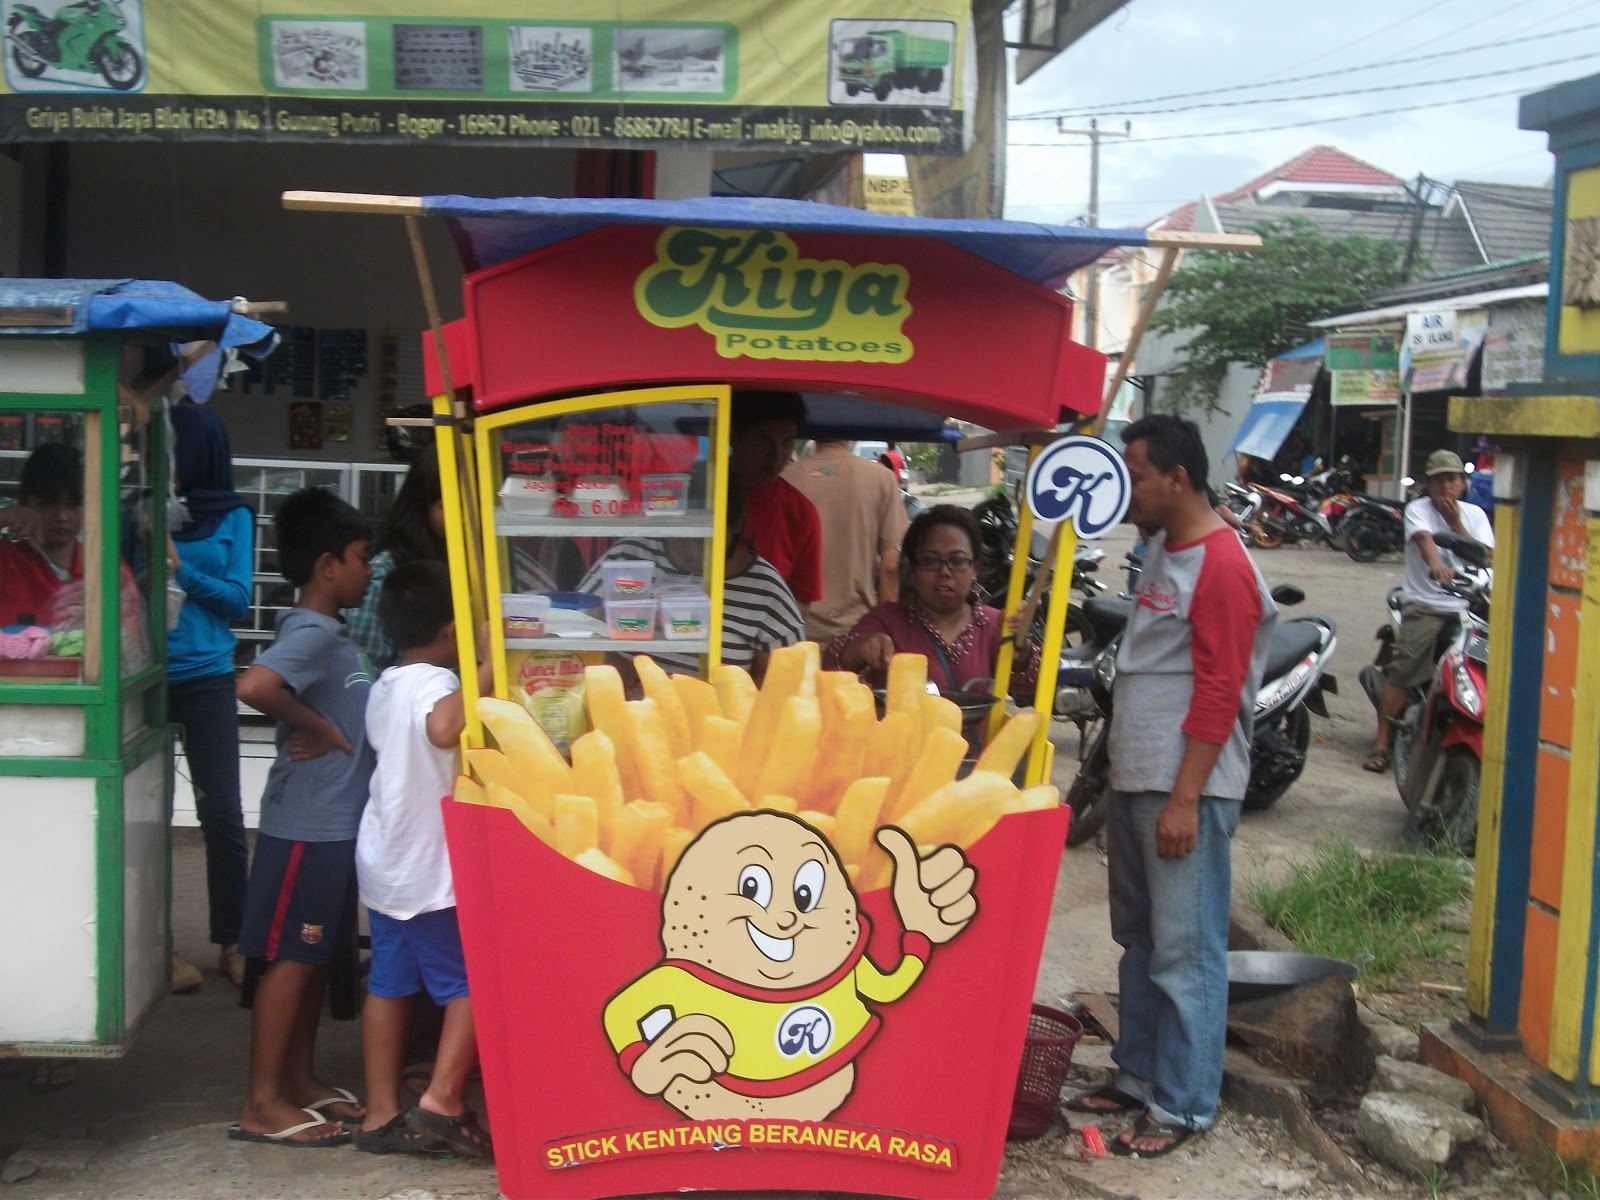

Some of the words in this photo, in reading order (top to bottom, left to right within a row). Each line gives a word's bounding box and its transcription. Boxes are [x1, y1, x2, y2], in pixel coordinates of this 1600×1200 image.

[25, 106, 70, 132] Griya
[72, 106, 115, 129] Bukit
[117, 107, 152, 134] Jaya
[154, 107, 192, 129] Blok
[276, 109, 339, 137] Gunung
[341, 111, 381, 133] Putri
[397, 112, 446, 139] Bogor
[458, 114, 507, 137] 16962
[509, 113, 561, 137] Phone
[571, 115, 601, 138] 021
[613, 116, 691, 139] 86862784
[693, 116, 743, 139] E-mail
[645, 228, 903, 332] Kiya
[1423, 313, 1443, 330] AIR
[725, 333, 904, 355] Potatoes
[546, 1135, 620, 1168] STICK
[624, 1124, 742, 1152] KENTANG
[748, 1124, 882, 1154] BERANEKA
[888, 1137, 953, 1168] RASA
